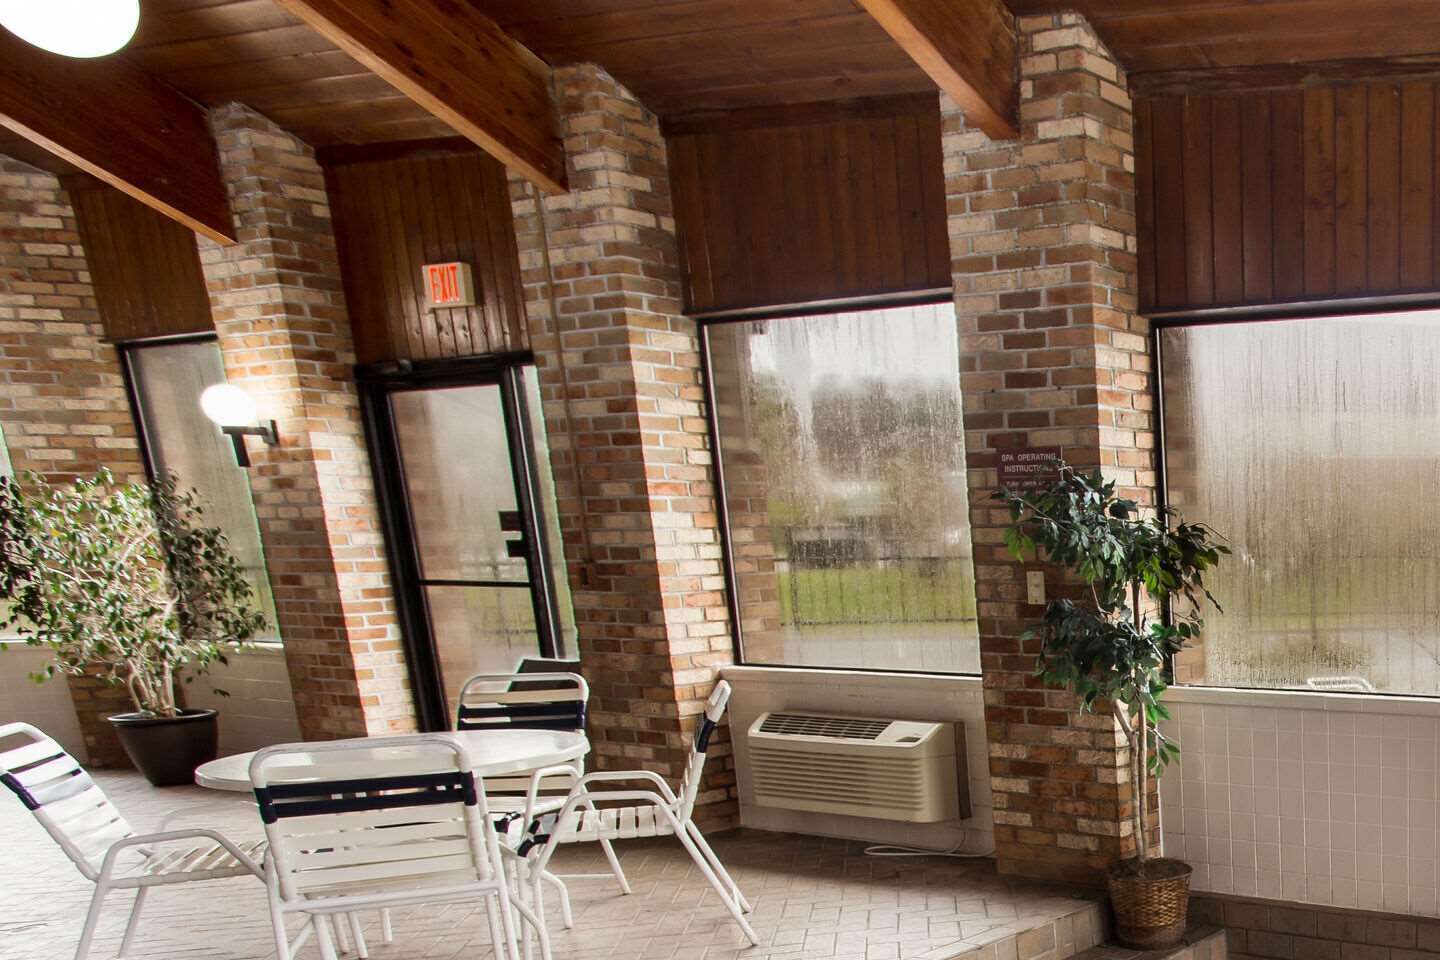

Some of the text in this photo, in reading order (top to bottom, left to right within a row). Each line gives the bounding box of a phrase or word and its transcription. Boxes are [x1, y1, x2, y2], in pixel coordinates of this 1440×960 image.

[429, 264, 459, 303] EXIT
[1018, 453, 1056, 461] OPERATING
[1005, 464, 1053, 473] INSTRUCTI
